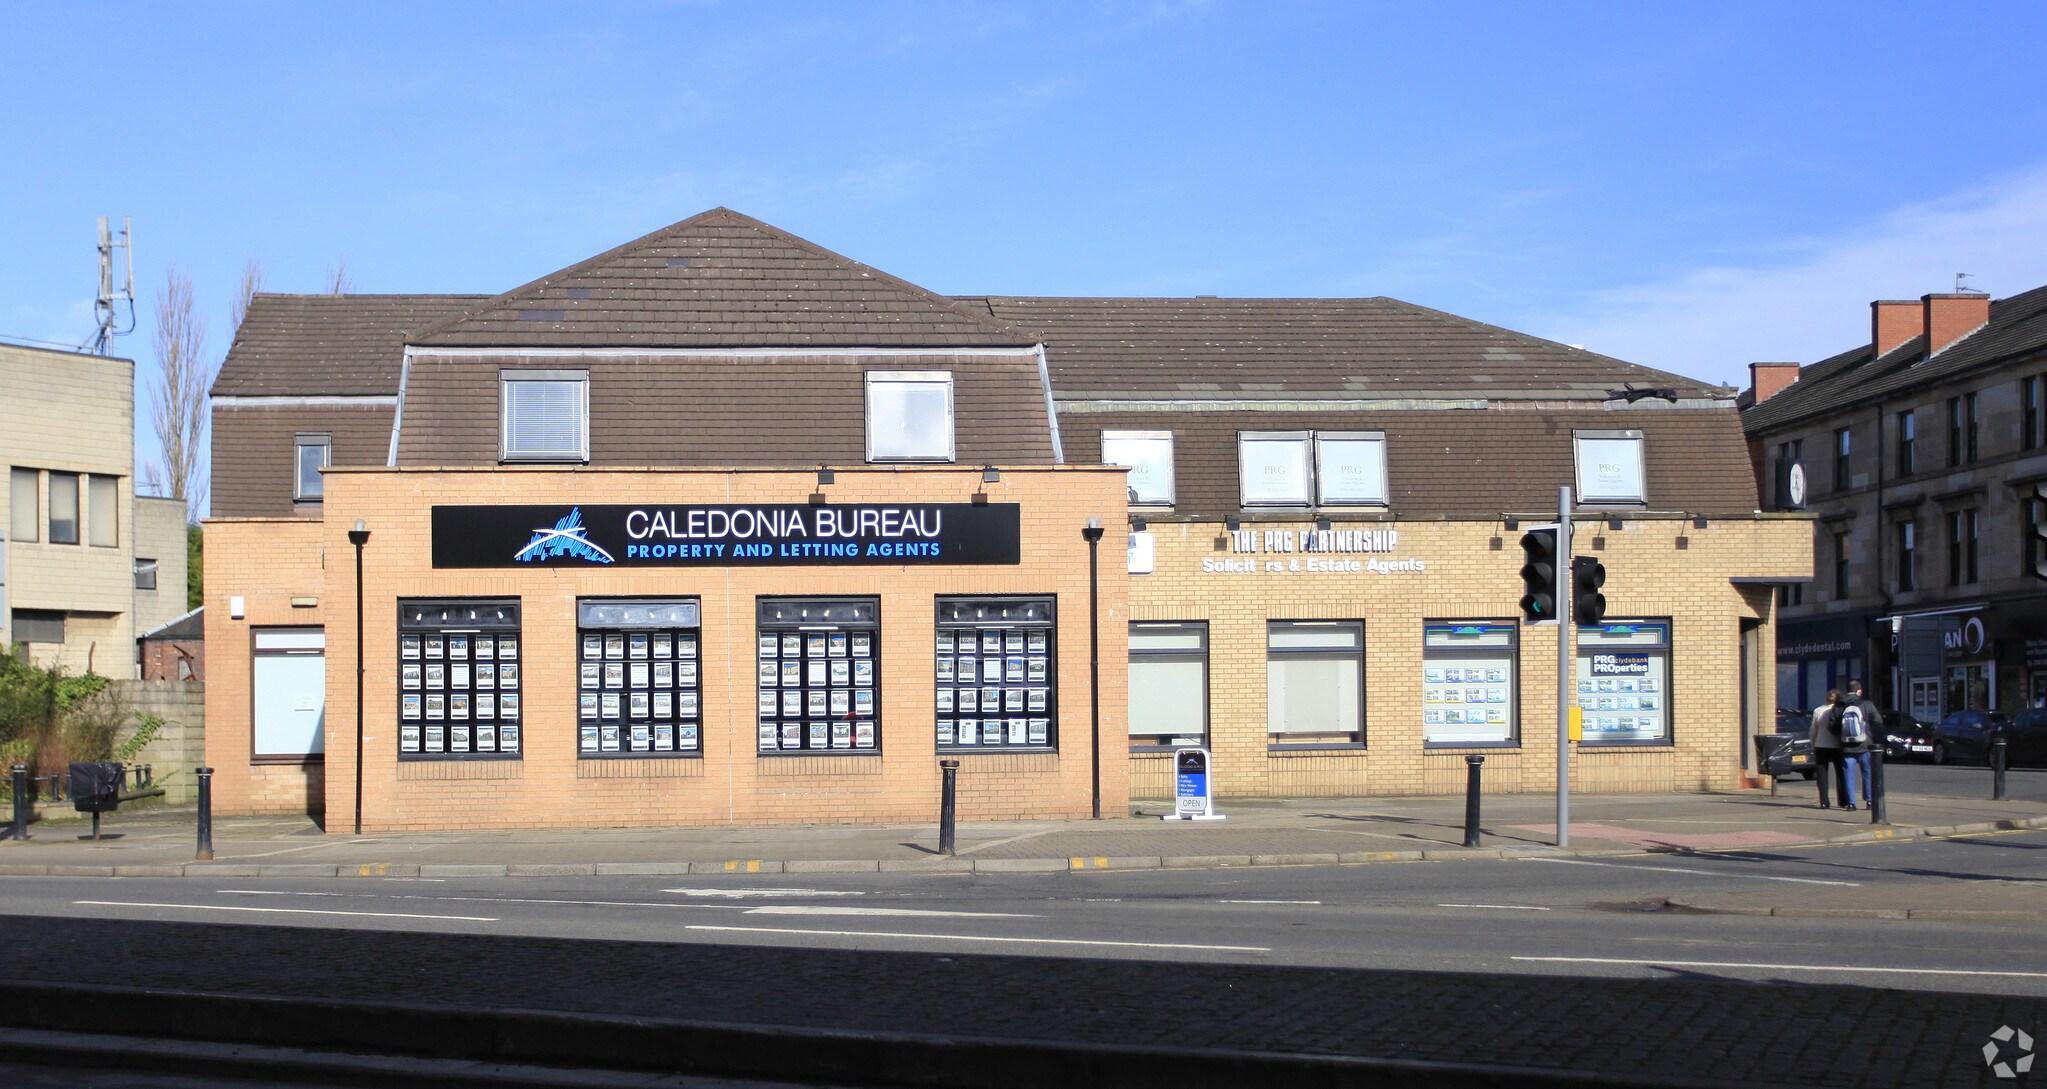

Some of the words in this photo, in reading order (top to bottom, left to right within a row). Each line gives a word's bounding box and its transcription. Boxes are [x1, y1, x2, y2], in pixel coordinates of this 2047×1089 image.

[1263, 465, 1286, 475] PRG
[1340, 465, 1363, 475] PRG
[1598, 463, 1621, 473] PRG
[626, 509, 807, 539] CALEDONIA
[816, 509, 942, 538] BUREAU
[1231, 530, 1258, 553] THE
[1263, 530, 1293, 553] PRG
[1299, 530, 1398, 553] PARTNERSHIP
[627, 544, 726, 558] PROPERTY
[732, 543, 774, 557] AND
[780, 543, 859, 557] LETTING
[866, 542, 941, 556] AGENTS
[1288, 558, 1301, 573] &
[1306, 557, 1362, 572] Estate
[1366, 557, 1426, 575] Agents
[1593, 654, 1616, 664] PRG
[1593, 663, 1648, 674] PROperties
[1182, 799, 1201, 807] OPEN
